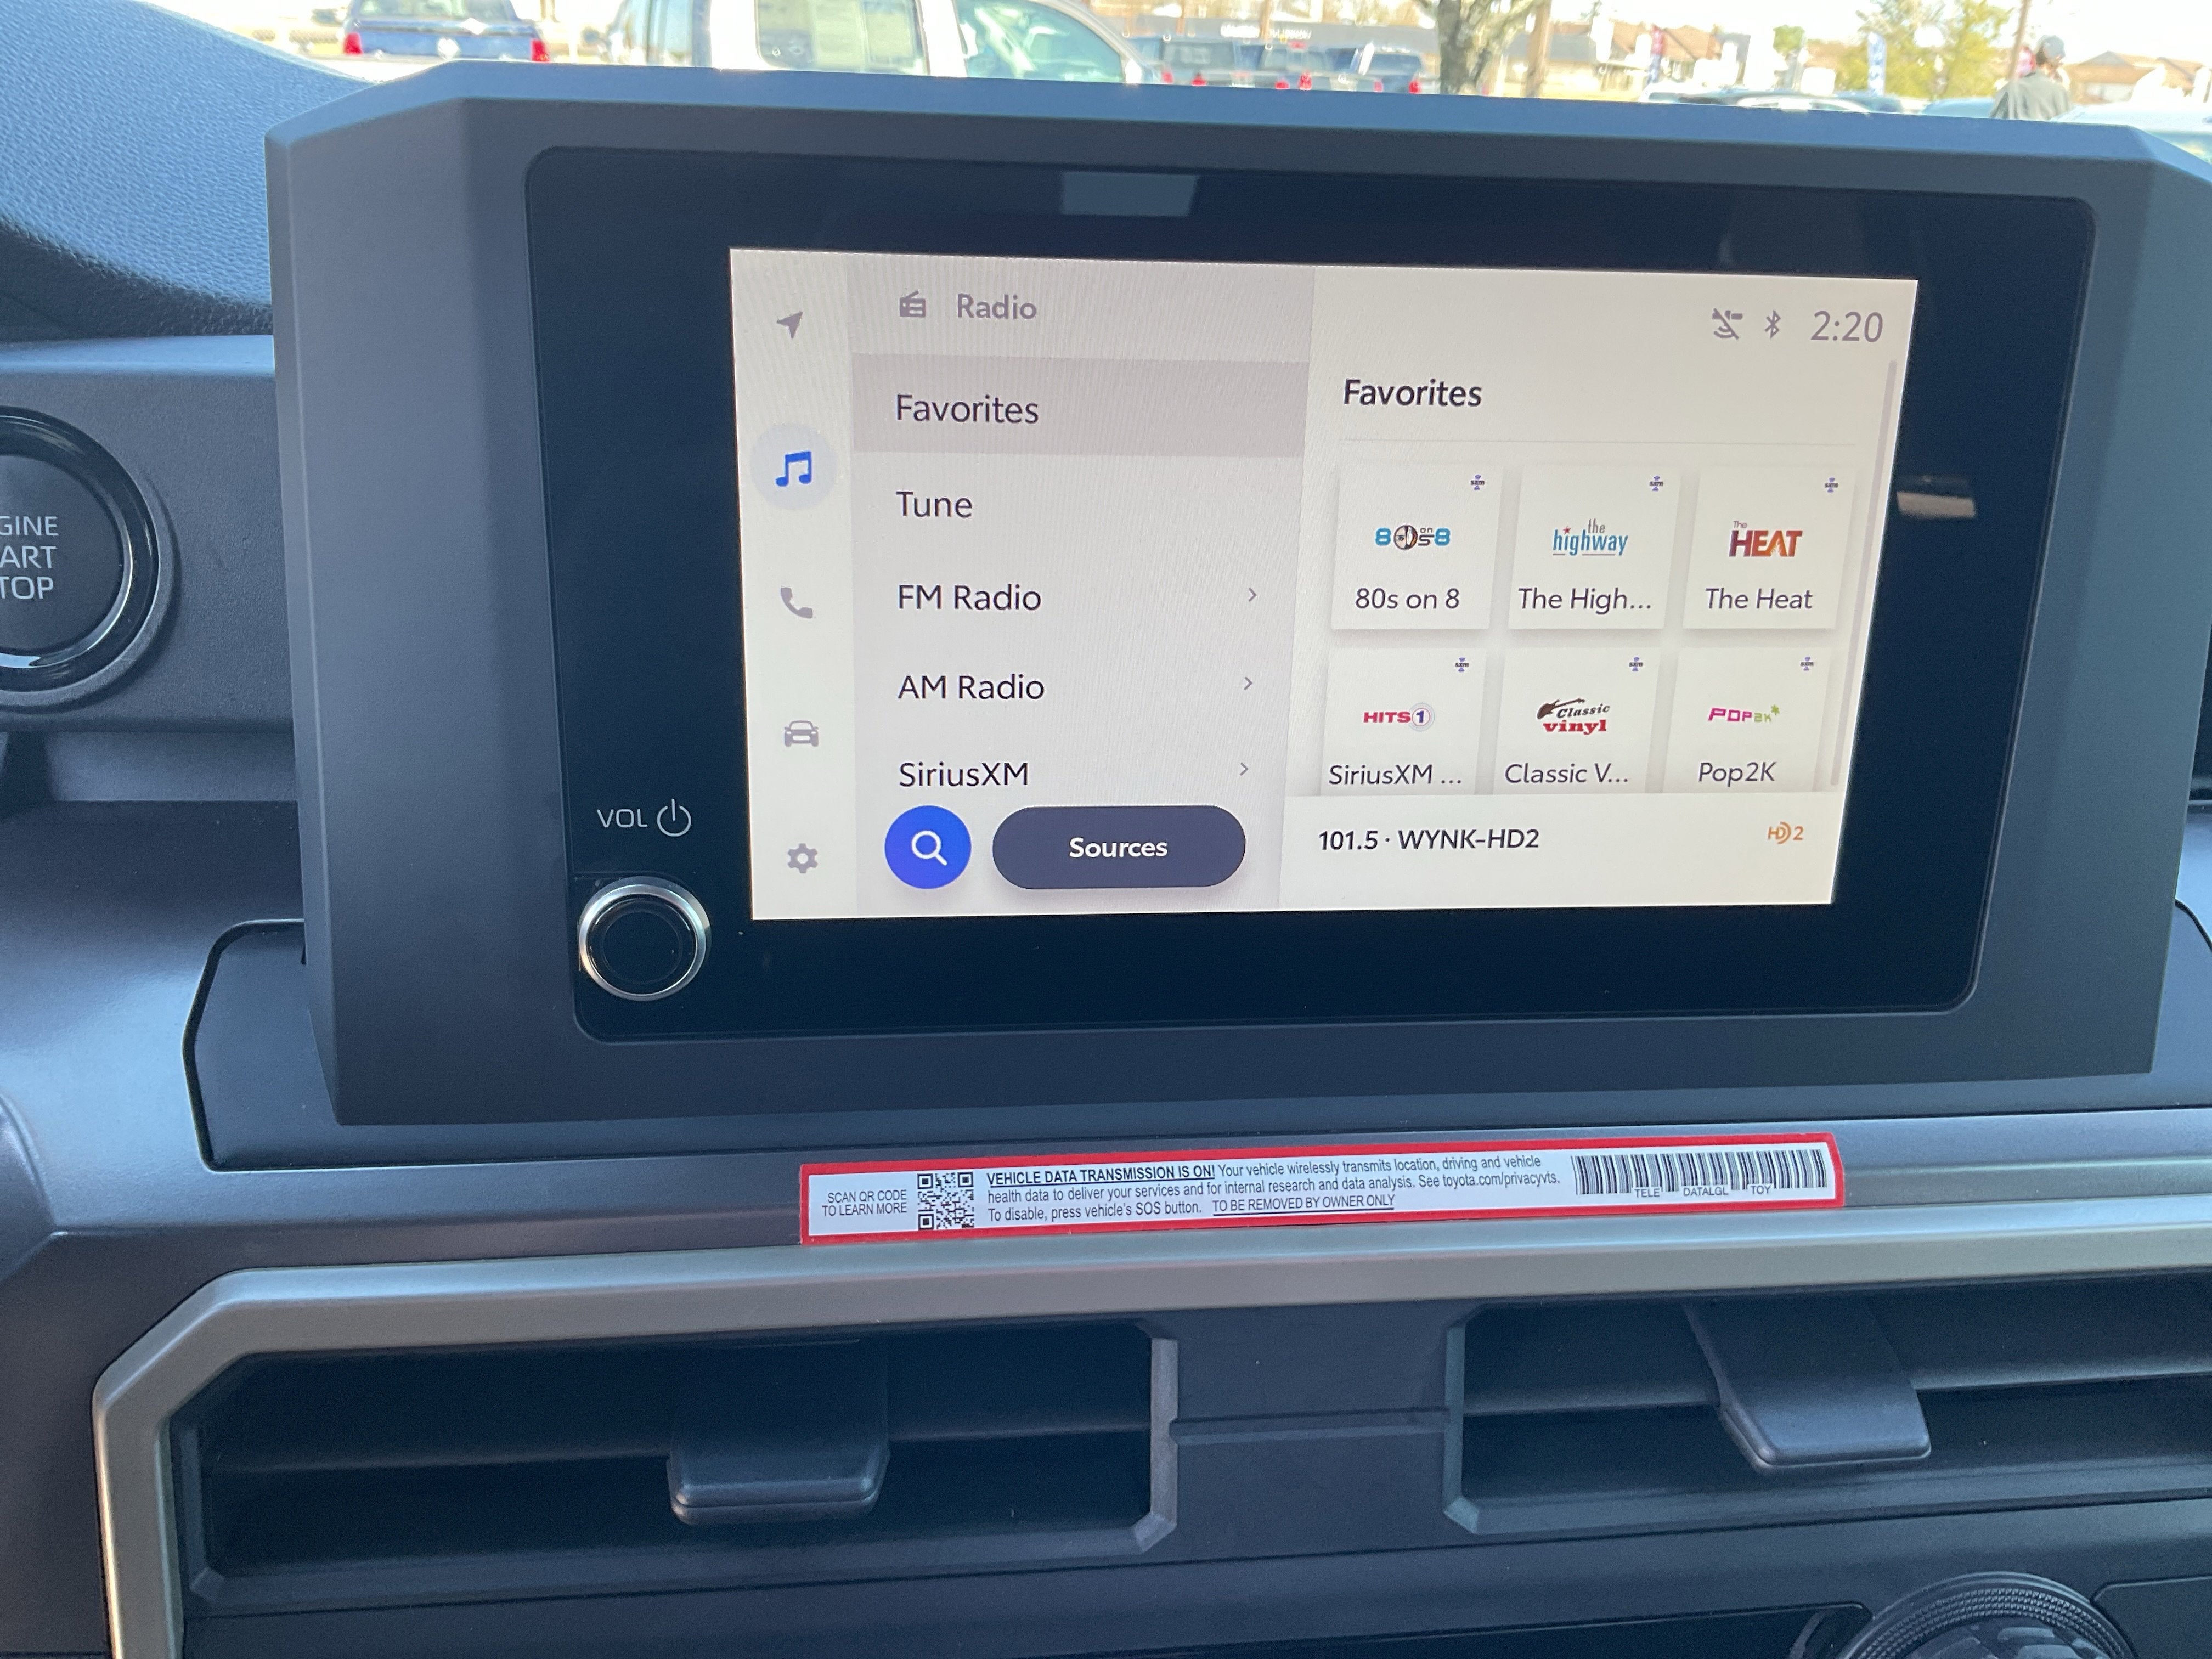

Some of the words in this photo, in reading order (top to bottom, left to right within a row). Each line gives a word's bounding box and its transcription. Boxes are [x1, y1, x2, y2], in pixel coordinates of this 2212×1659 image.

[957, 294, 1037, 319] Radio
[1810, 310, 1884, 343] 2:20
[1344, 378, 1483, 408] Favorites
[895, 394, 1039, 424] Favorites
[895, 490, 973, 518] Tune
[1434, 527, 1451, 546] 8
[1588, 518, 1606, 534] the
[1553, 526, 1629, 556] highway
[1729, 529, 1803, 557] HEAT
[898, 584, 942, 610] FM
[953, 583, 1041, 611] Radio
[1355, 588, 1398, 610] 80s
[1406, 594, 1437, 610] on
[1445, 588, 1460, 610] 8
[1518, 587, 1562, 610] The
[1570, 588, 1652, 615] High...
[1705, 587, 1748, 610] The
[1756, 588, 1813, 610] Heat
[897, 675, 947, 699] AM
[958, 674, 1045, 700] Radio
[1363, 712, 1412, 724] HITS
[1557, 703, 1610, 718] Classic
[1543, 719, 1607, 735] vinyl
[899, 761, 1029, 787] SiriusXM
[1329, 764, 1433, 785] SiriusXM
[1505, 763, 1587, 783] Classic
[1595, 763, 1629, 783] V...
[1698, 761, 1778, 787] Pop2K
[596, 808, 648, 828] VOL
[1069, 837, 1168, 859] Sources
[1318, 830, 1379, 851] 101.5
[1397, 828, 1540, 850] WYNK-HD2
[987, 1171, 1041, 1185] VEHICLE
[1045, 1169, 1077, 1183] DATA
[1080, 1166, 1175, 1182] TRANSMISSION
[1179, 1166, 1190, 1178] IS
[1193, 1165, 1215, 1178] ON!
[1218, 1164, 1243, 1178] Your
[1246, 1161, 1284, 1176] vehicle
[1287, 1160, 1340, 1176] wirelessly
[1343, 1158, 1391, 1172] transmits
[1395, 1158, 1440, 1172] location,
[1442, 1156, 1478, 1172] driving
[1481, 1155, 1501, 1169] and
[1504, 1154, 1541, 1168] vehicle
[827, 1192, 856, 1203] SCAN
[859, 1190, 874, 1202] QR
[878, 1189, 907, 1201] CODE
[988, 1189, 1022, 1203] health
[1025, 1188, 1049, 1202] data
[1053, 1188, 1063, 1201] to
[1068, 1186, 1104, 1200] deliver
[1107, 1186, 1132, 1201] your
[1135, 1183, 1180, 1198] services
[1183, 1181, 1204, 1195] and
[1207, 1181, 1221, 1195] for
[1224, 1180, 1265, 1194] internal
[1268, 1178, 1316, 1193] research
[1319, 1177, 1339, 1191] and
[1342, 1176, 1365, 1190] data
[1368, 1174, 1415, 1191] analysis.
[1418, 1173, 1440, 1188] See
[1442, 1170, 1561, 1189] toyota.com/privacyvts.
[1634, 1188, 1660, 1198] TELE
[1683, 1186, 1729, 1197] DATALGL
[1750, 1184, 1771, 1195] TOY
[822, 1205, 836, 1217] TO
[839, 1204, 874, 1216] LEARN
[876, 1203, 907, 1215] MORE
[988, 1208, 1001, 1222] To
[1005, 1206, 1048, 1221] disable,
[1051, 1205, 1081, 1222] press
[1085, 1202, 1132, 1218] vehicle's
[1135, 1201, 1161, 1216] SOS
[1164, 1200, 1202, 1215] button.
[1212, 1199, 1227, 1212] TO
[1231, 1199, 1245, 1211] BE
[1248, 1197, 1304, 1211] REMOVED
[1306, 1195, 1321, 1209] BY
[1322, 1194, 1364, 1208] OWNER
[1366, 1193, 1396, 1207] ONLY
